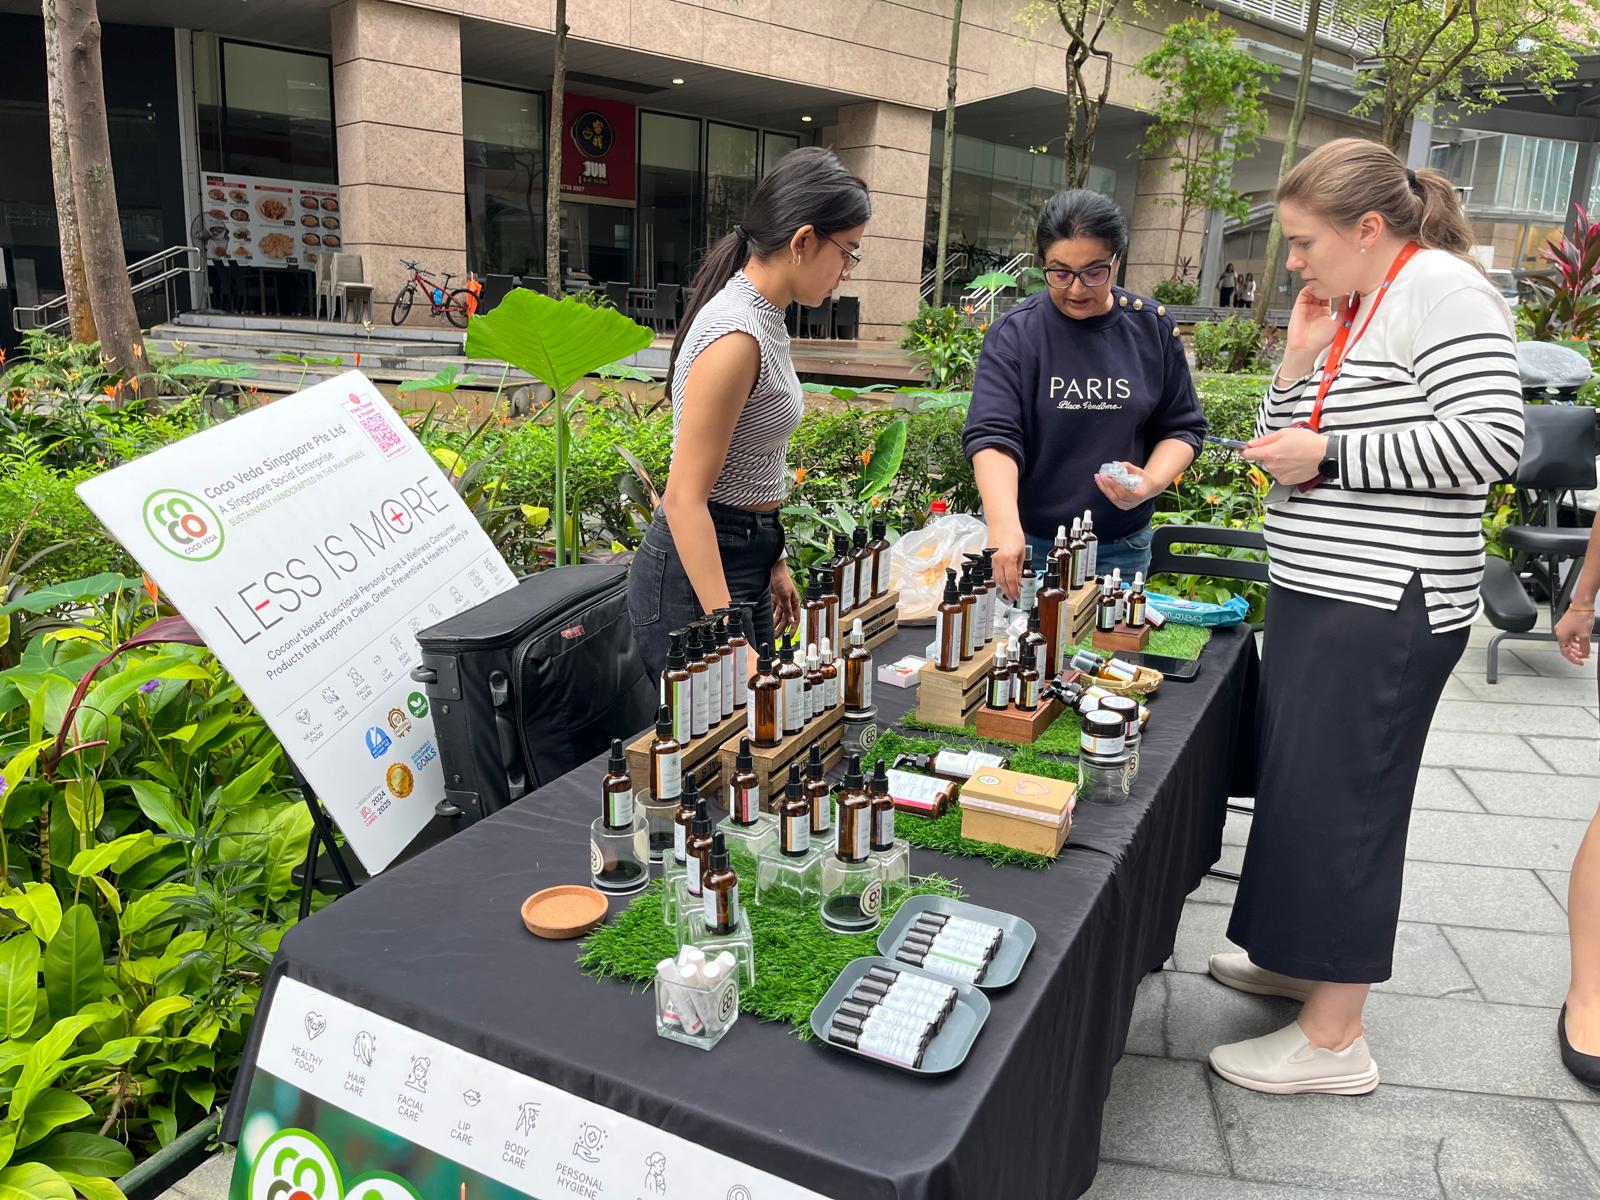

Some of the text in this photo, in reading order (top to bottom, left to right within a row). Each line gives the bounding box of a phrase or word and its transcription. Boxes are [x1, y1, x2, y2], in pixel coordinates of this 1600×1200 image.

[583, 161, 606, 178] JUN
[1050, 376, 1131, 399] PARIS
[1057, 400, 1082, 410] Place
[204, 424, 346, 498] Coco Veda Singapore Pte Ltd
[219, 452, 334, 515] A Singapore Social Enterprise
[228, 499, 272, 526] SUSTAINABLY
[270, 476, 317, 504] HANDCRAFTED
[314, 471, 324, 481] IN
[321, 466, 336, 476] THE
[333, 450, 365, 472] PHILIPPINES
[184, 534, 220, 557] COCO VEDA
[214, 476, 449, 645] LESS IS MORE
[267, 633, 303, 660] Coconut
[300, 615, 325, 636] based
[324, 590, 360, 621] Functional
[358, 571, 387, 595] Personal
[385, 563, 402, 576] Care
[404, 542, 431, 562] Wellness
[429, 524, 456, 544] Consumer
[266, 652, 304, 680] Products
[303, 639, 320, 654] that
[320, 618, 348, 642] support
[351, 601, 374, 618] Clean,
[372, 585, 394, 603] Green,
[391, 563, 423, 588] Preventive
[421, 558, 428, 566] &
[426, 544, 449, 562] Healthy
[446, 529, 469, 548] Lifestyle
[383, 672, 394, 682] CARE
[359, 687, 372, 700] CARE
[334, 705, 345, 715] HAIR
[335, 707, 349, 721] CARE
[303, 723, 322, 741] HEALTHY
[307, 728, 325, 744] FOOD
[416, 747, 437, 771] GOALS
[371, 790, 386, 806] 2024
[377, 800, 392, 815] 2025
[292, 1045, 323, 1065] HEALTHY
[294, 1059, 315, 1074] FOOD
[347, 1071, 366, 1086] HAIR
[344, 1081, 365, 1097] CARE
[397, 1094, 424, 1113] FACIAL
[398, 1105, 419, 1122] CARE
[458, 1120, 471, 1132] LIP
[450, 1129, 474, 1146] CARE
[504, 1140, 530, 1157] BODY
[502, 1153, 527, 1170] CARE
[555, 1163, 603, 1192] PERSONAL
[557, 1176, 598, 1200] HYGIENE
